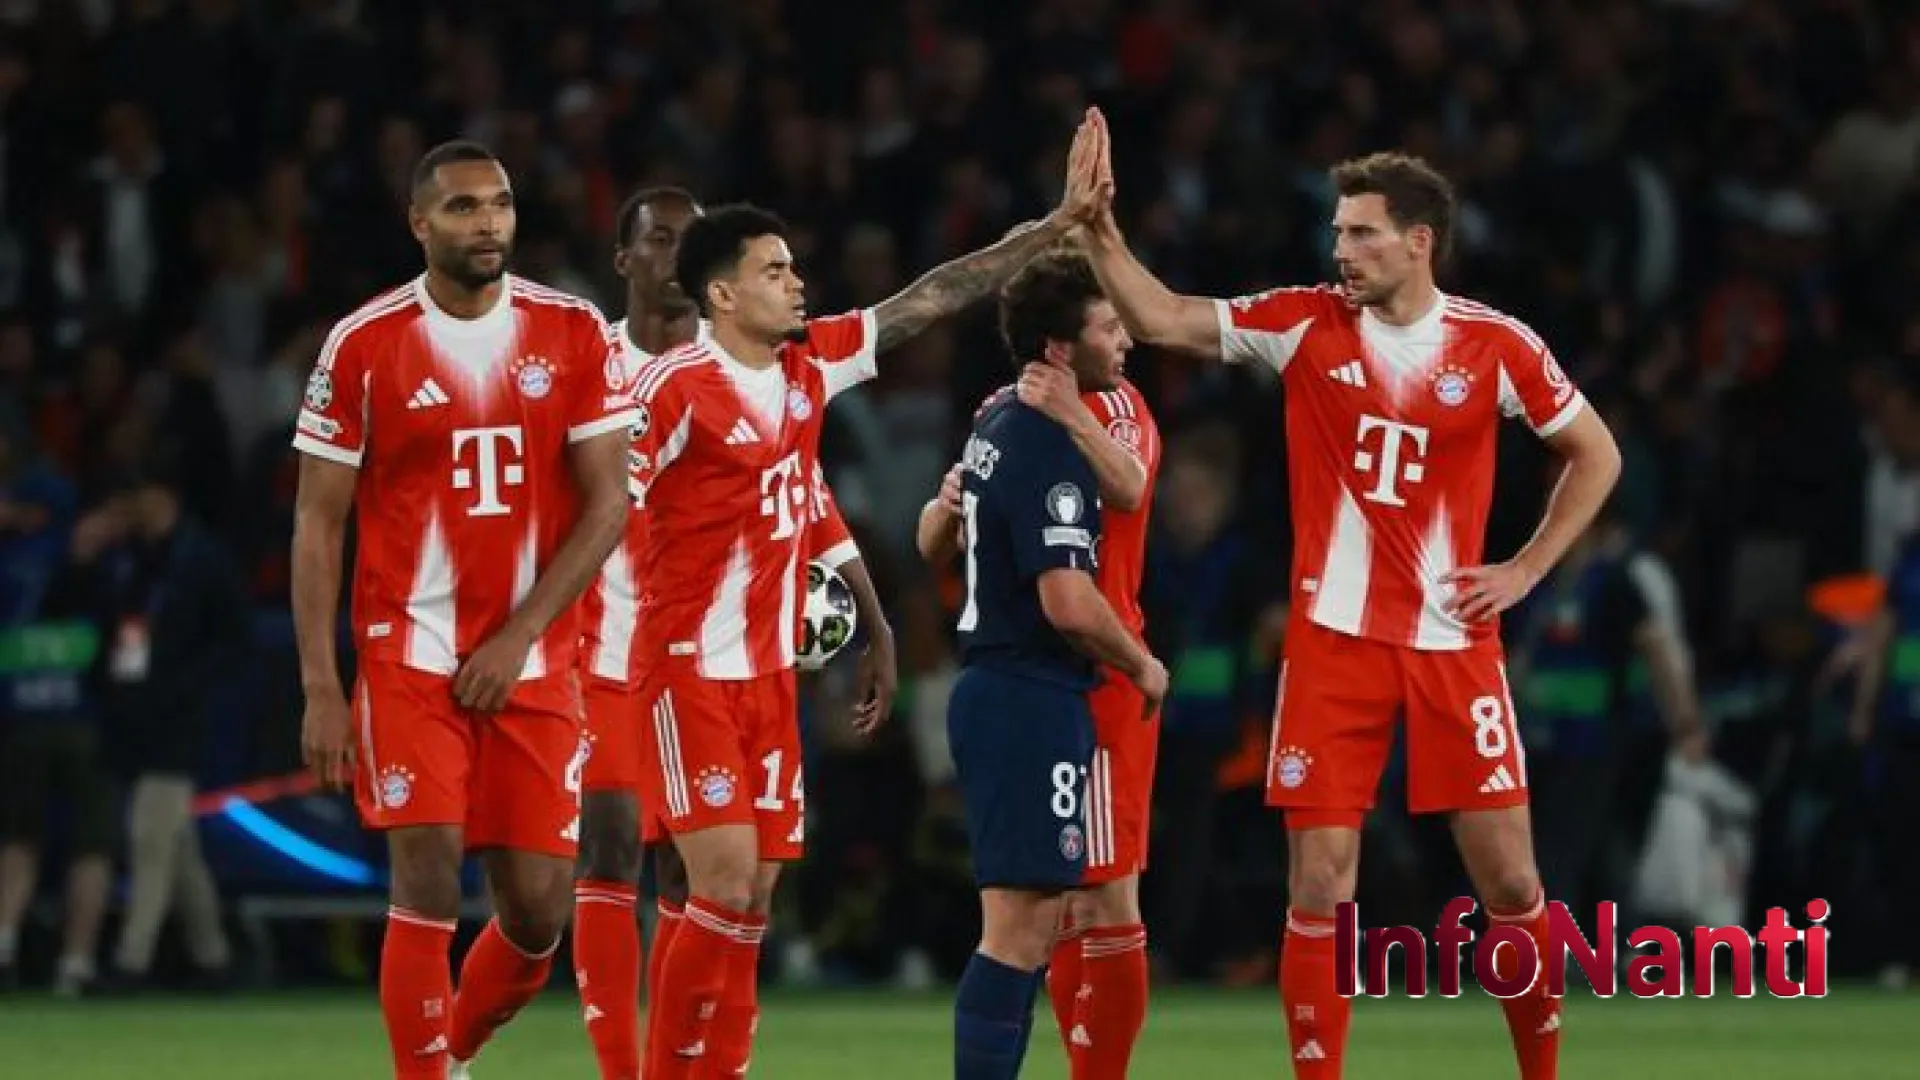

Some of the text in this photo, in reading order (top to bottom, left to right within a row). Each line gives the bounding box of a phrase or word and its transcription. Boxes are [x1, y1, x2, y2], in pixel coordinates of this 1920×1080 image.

[452, 424, 525, 517] T
[760, 451, 805, 541] T
[1354, 414, 1429, 507] T
[1471, 696, 1507, 758] 8
